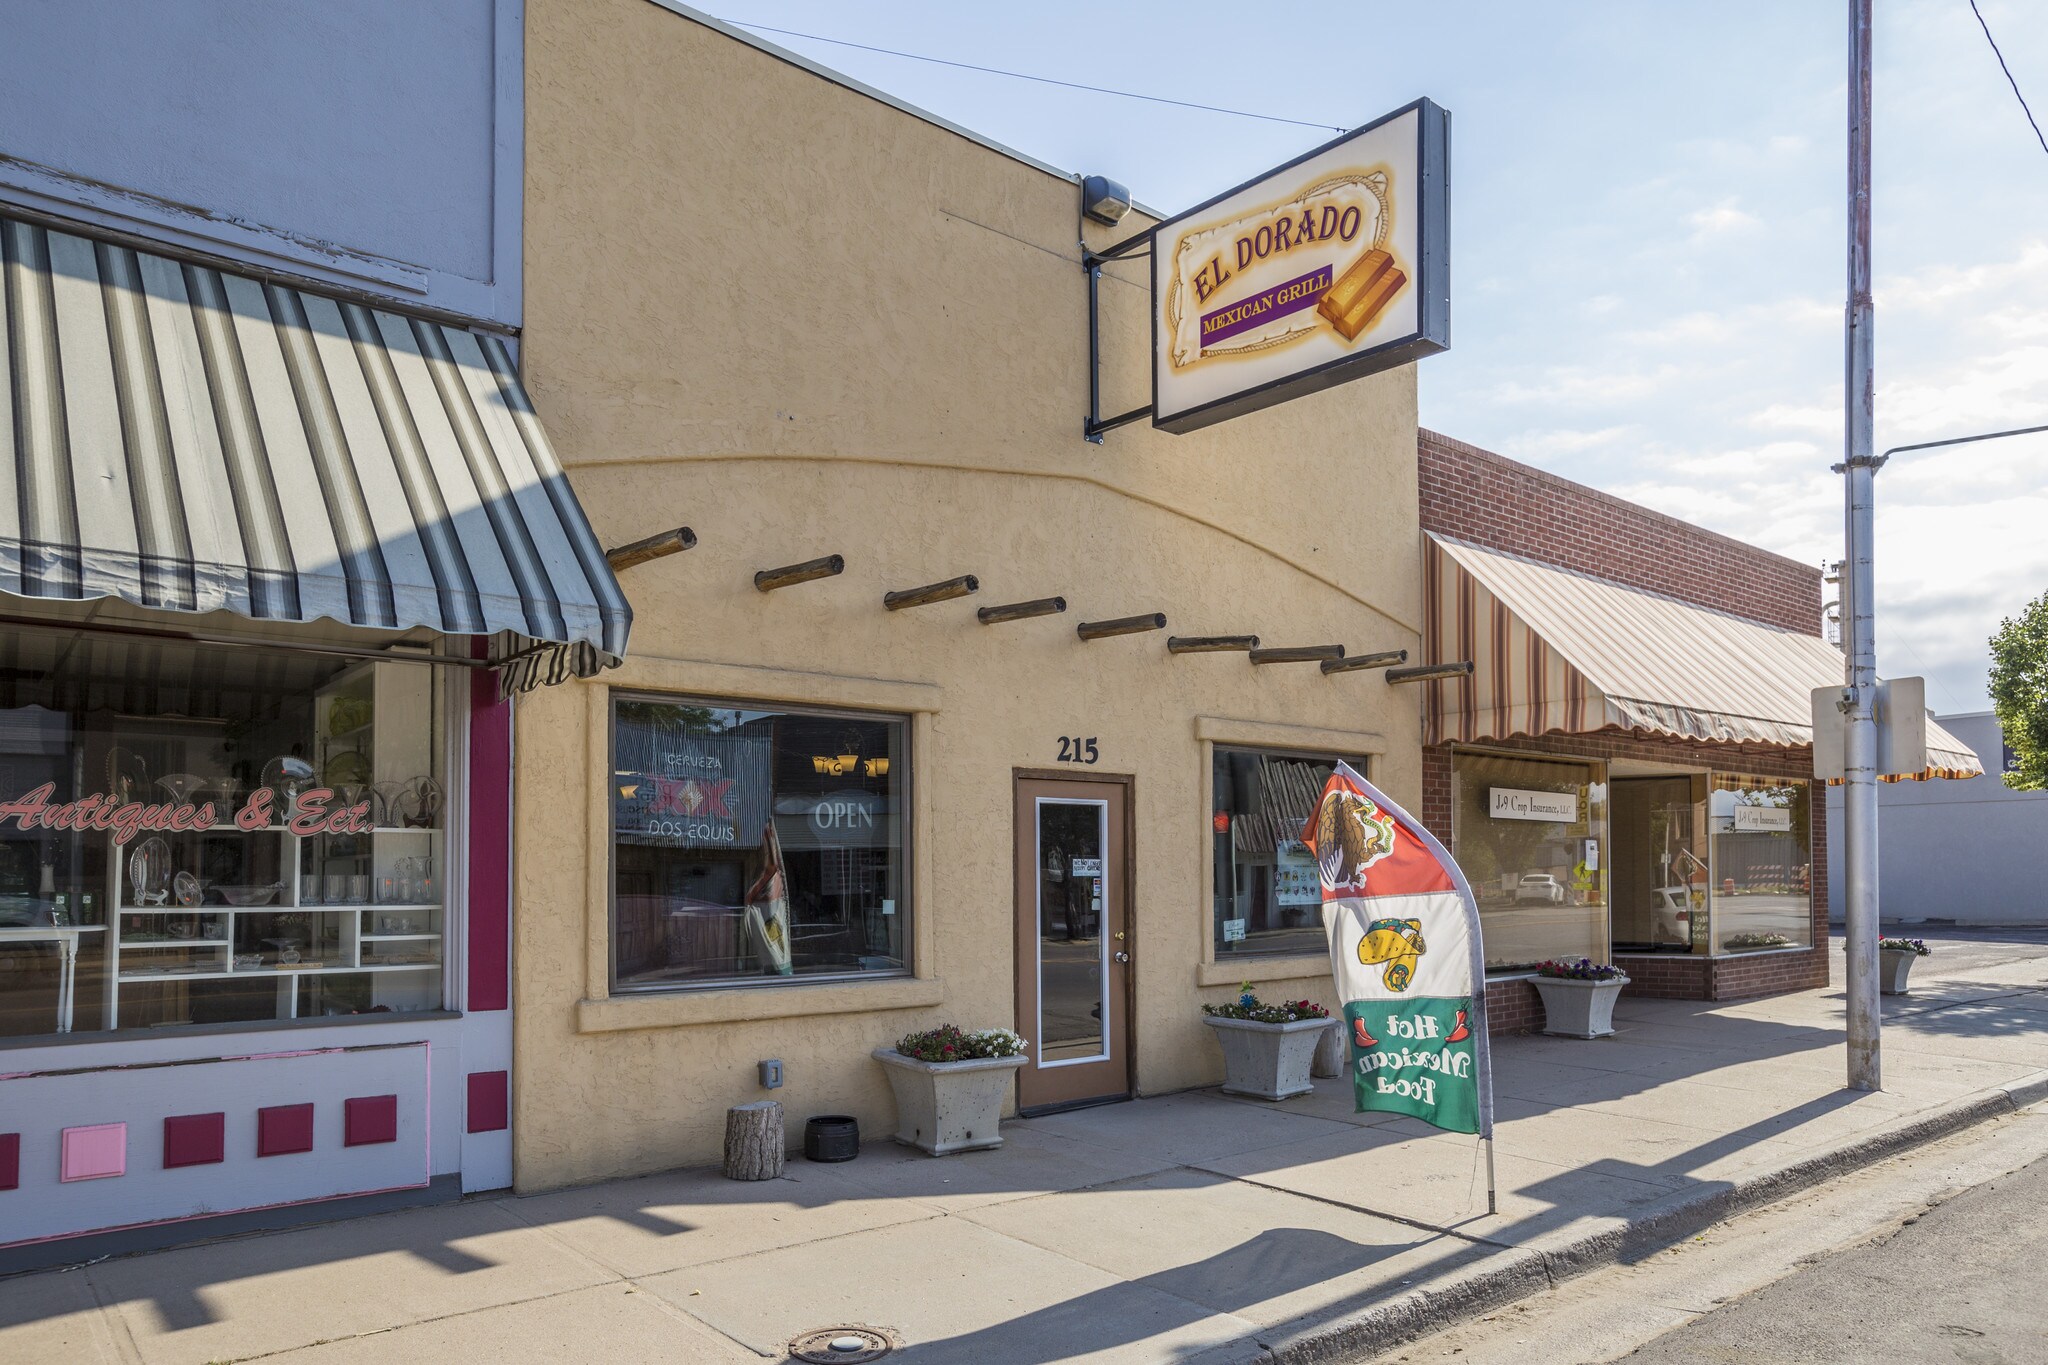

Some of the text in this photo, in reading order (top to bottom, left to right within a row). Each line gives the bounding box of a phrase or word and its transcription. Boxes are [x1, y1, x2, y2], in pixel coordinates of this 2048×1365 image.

[1193, 205, 1361, 304] EL DORADO
[1203, 273, 1329, 335] MEXICAN GRILL
[667, 754, 722, 769] CERVEZA
[1057, 736, 1098, 764] 215
[0, 781, 376, 847] Antiques & Ect.
[815, 801, 873, 829] OPEN
[1511, 795, 1528, 816] Crop
[1530, 796, 1560, 816] Insurance,
[648, 819, 683, 837] DOS
[688, 823, 735, 841] EQUIS
